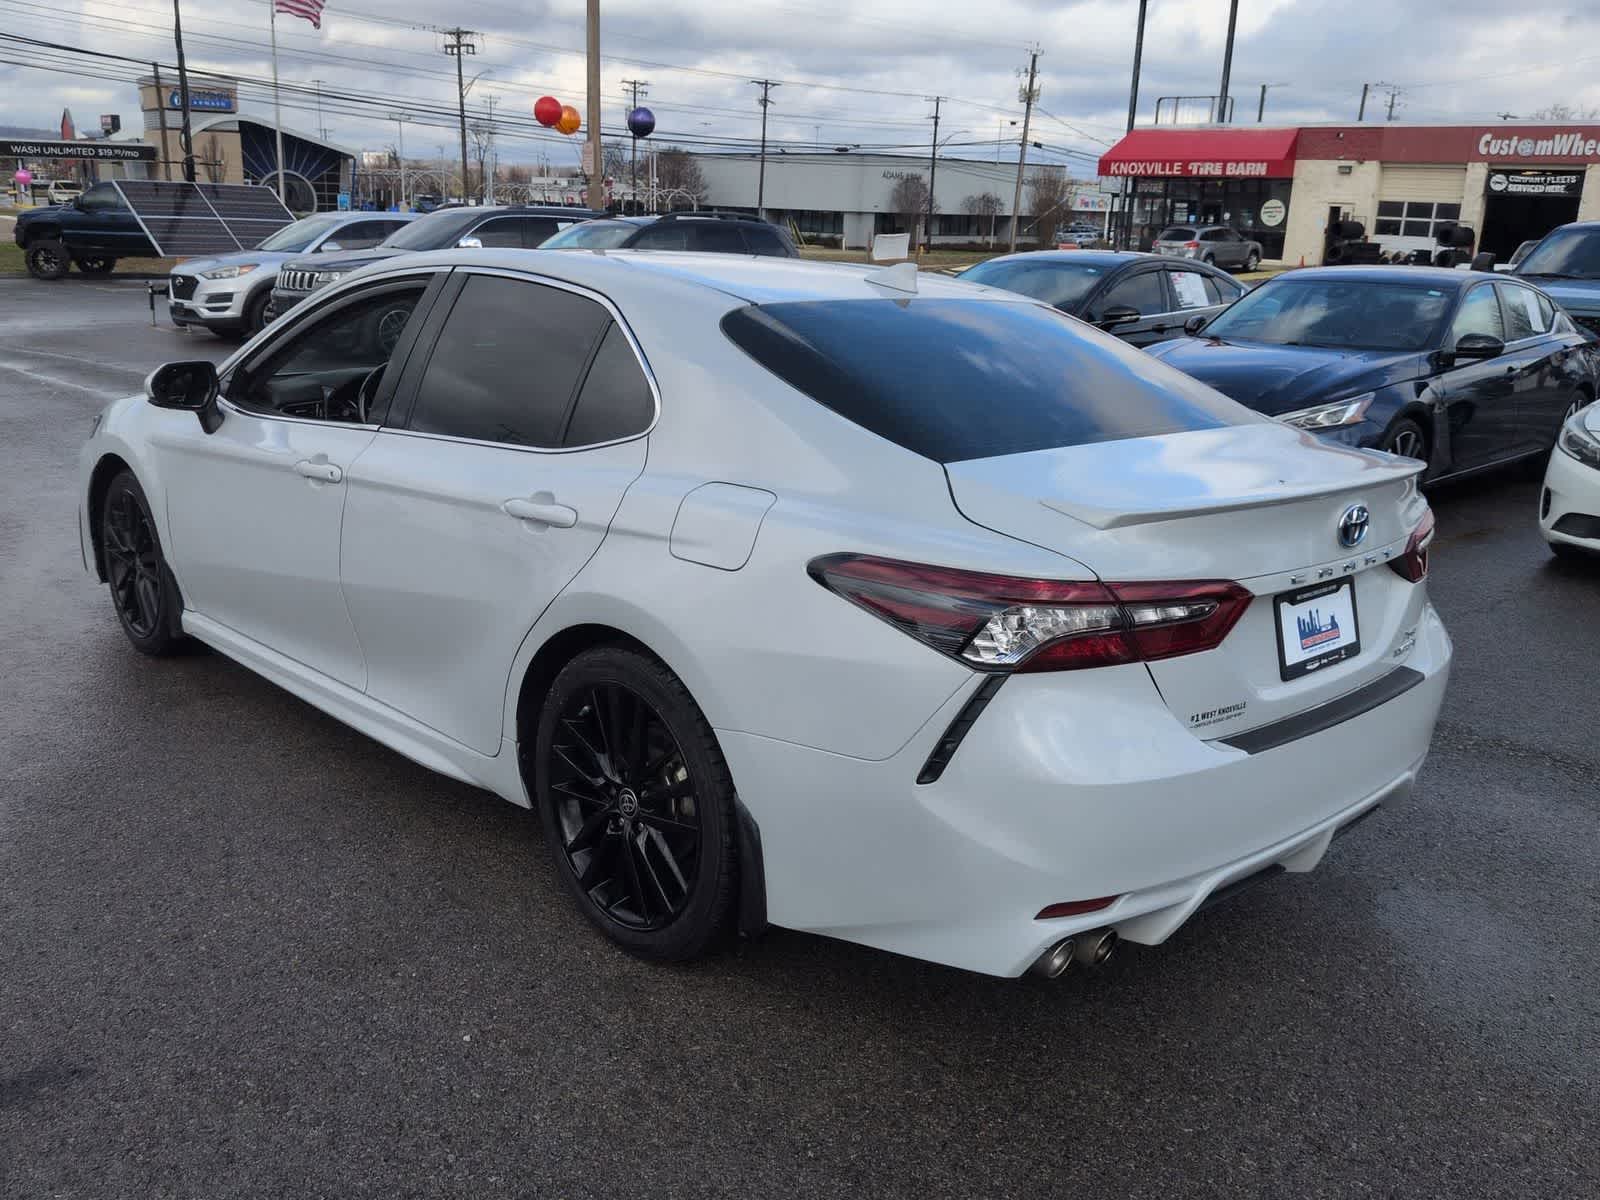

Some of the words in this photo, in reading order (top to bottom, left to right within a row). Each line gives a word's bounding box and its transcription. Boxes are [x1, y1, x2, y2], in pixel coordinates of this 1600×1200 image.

[10, 145, 41, 154] WASH
[43, 146, 95, 156] UNLIMITED
[1110, 162, 1183, 175] KNOXVILLE
[1188, 162, 1222, 175] TIRE
[1225, 162, 1268, 175] BARN
[1508, 175, 1546, 183] COMPANY
[1547, 175, 1577, 184] FLEETS
[1507, 184, 1545, 193] SERVICED
